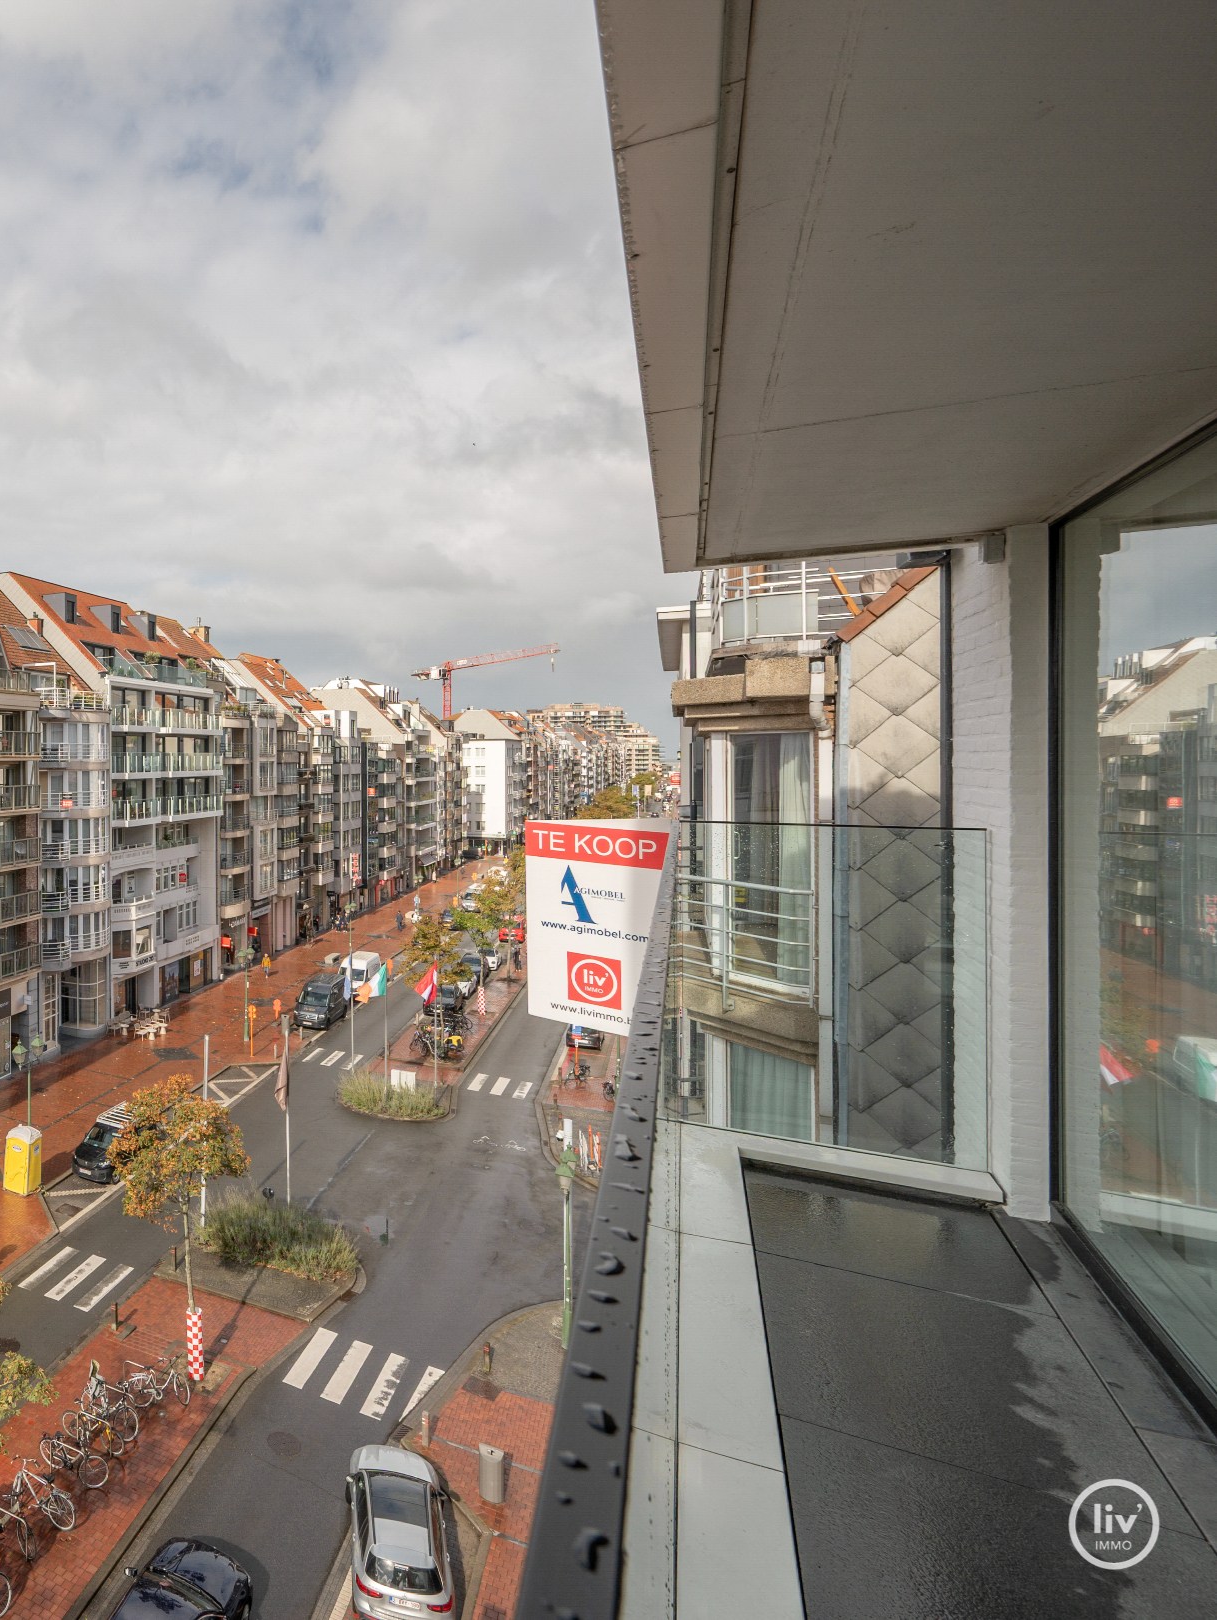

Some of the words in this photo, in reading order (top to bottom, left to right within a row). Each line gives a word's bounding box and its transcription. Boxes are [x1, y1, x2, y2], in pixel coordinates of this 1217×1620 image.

[532, 829, 566, 852] TE
[574, 833, 657, 860] KOOP
[574, 887, 626, 900] AGIMOBEL
[541, 920, 649, 943] www.agimobel.com
[584, 986, 604, 994] IMMO
